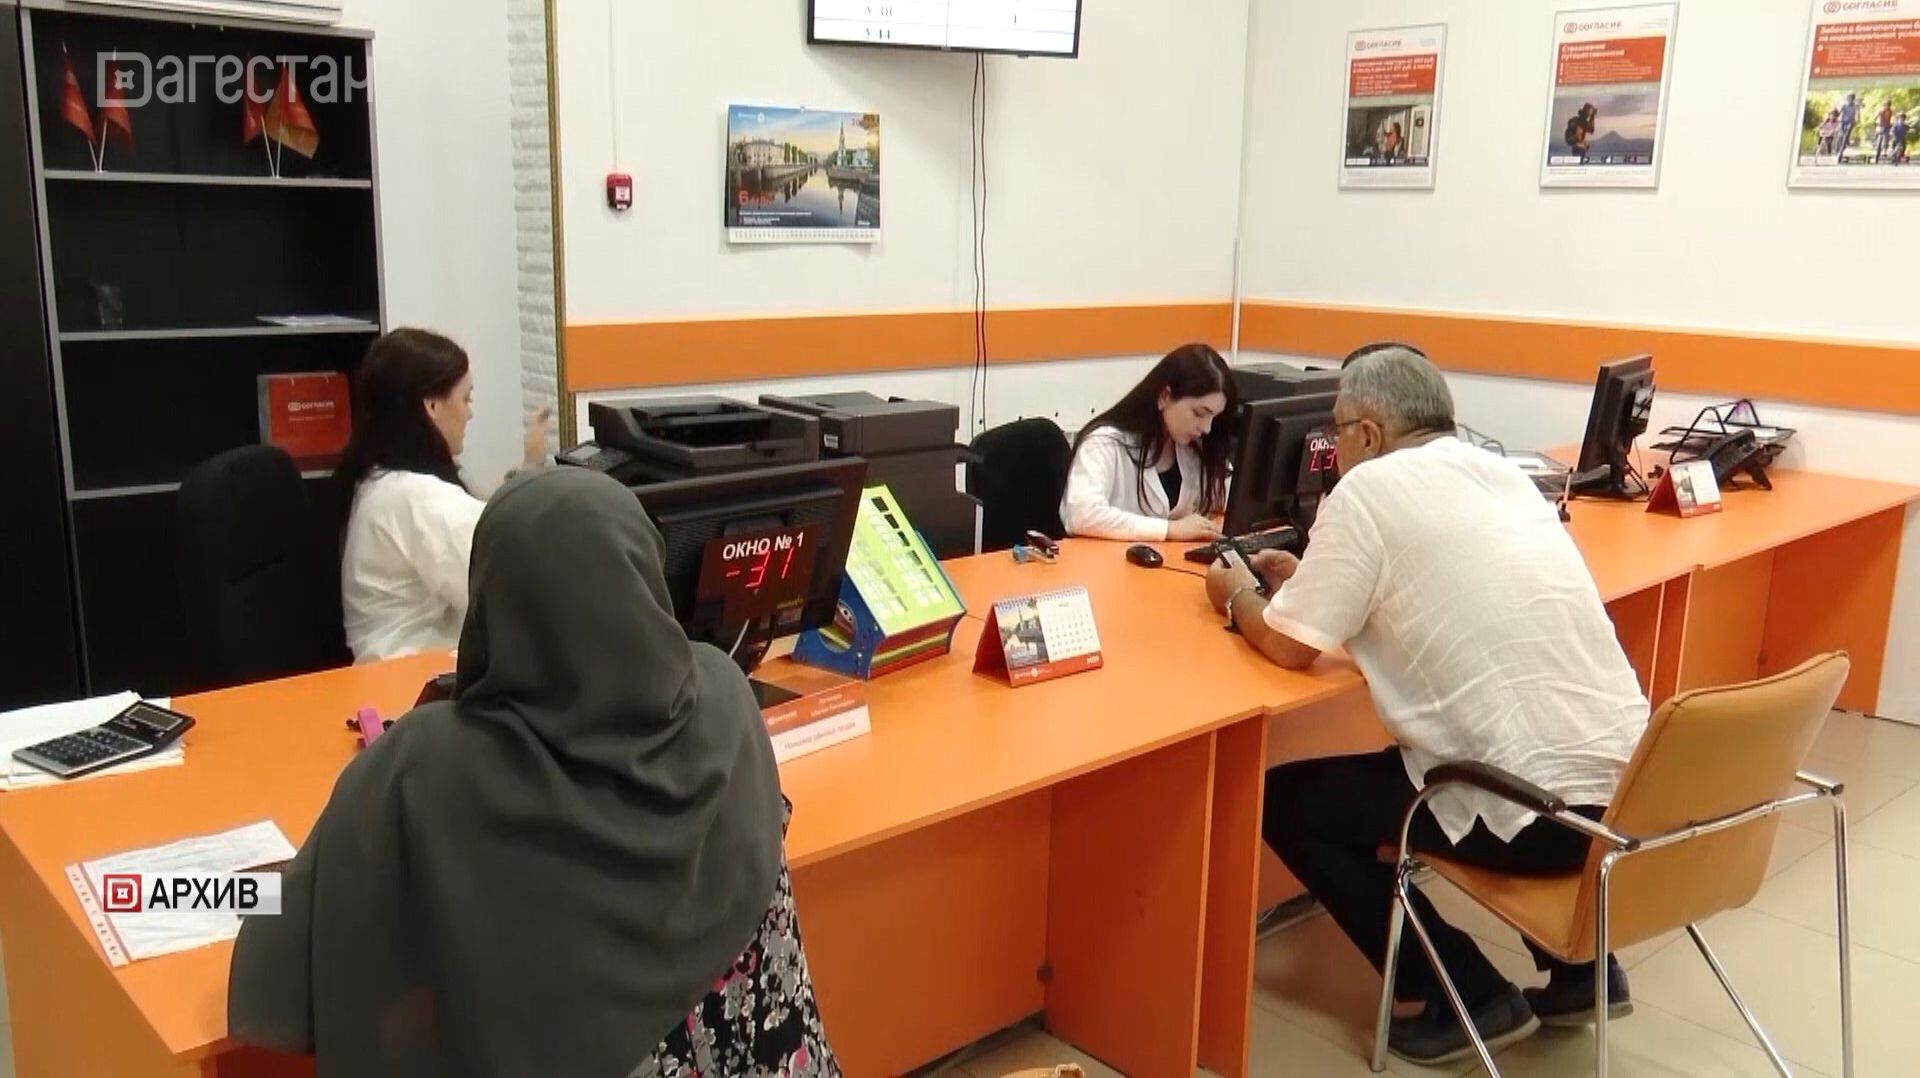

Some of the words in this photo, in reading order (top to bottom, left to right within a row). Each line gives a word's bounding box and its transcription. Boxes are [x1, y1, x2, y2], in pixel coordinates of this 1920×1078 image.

[722, 537, 771, 561] ОКНО
[774, 533, 793, 552] №
[796, 531, 804, 548] 1
